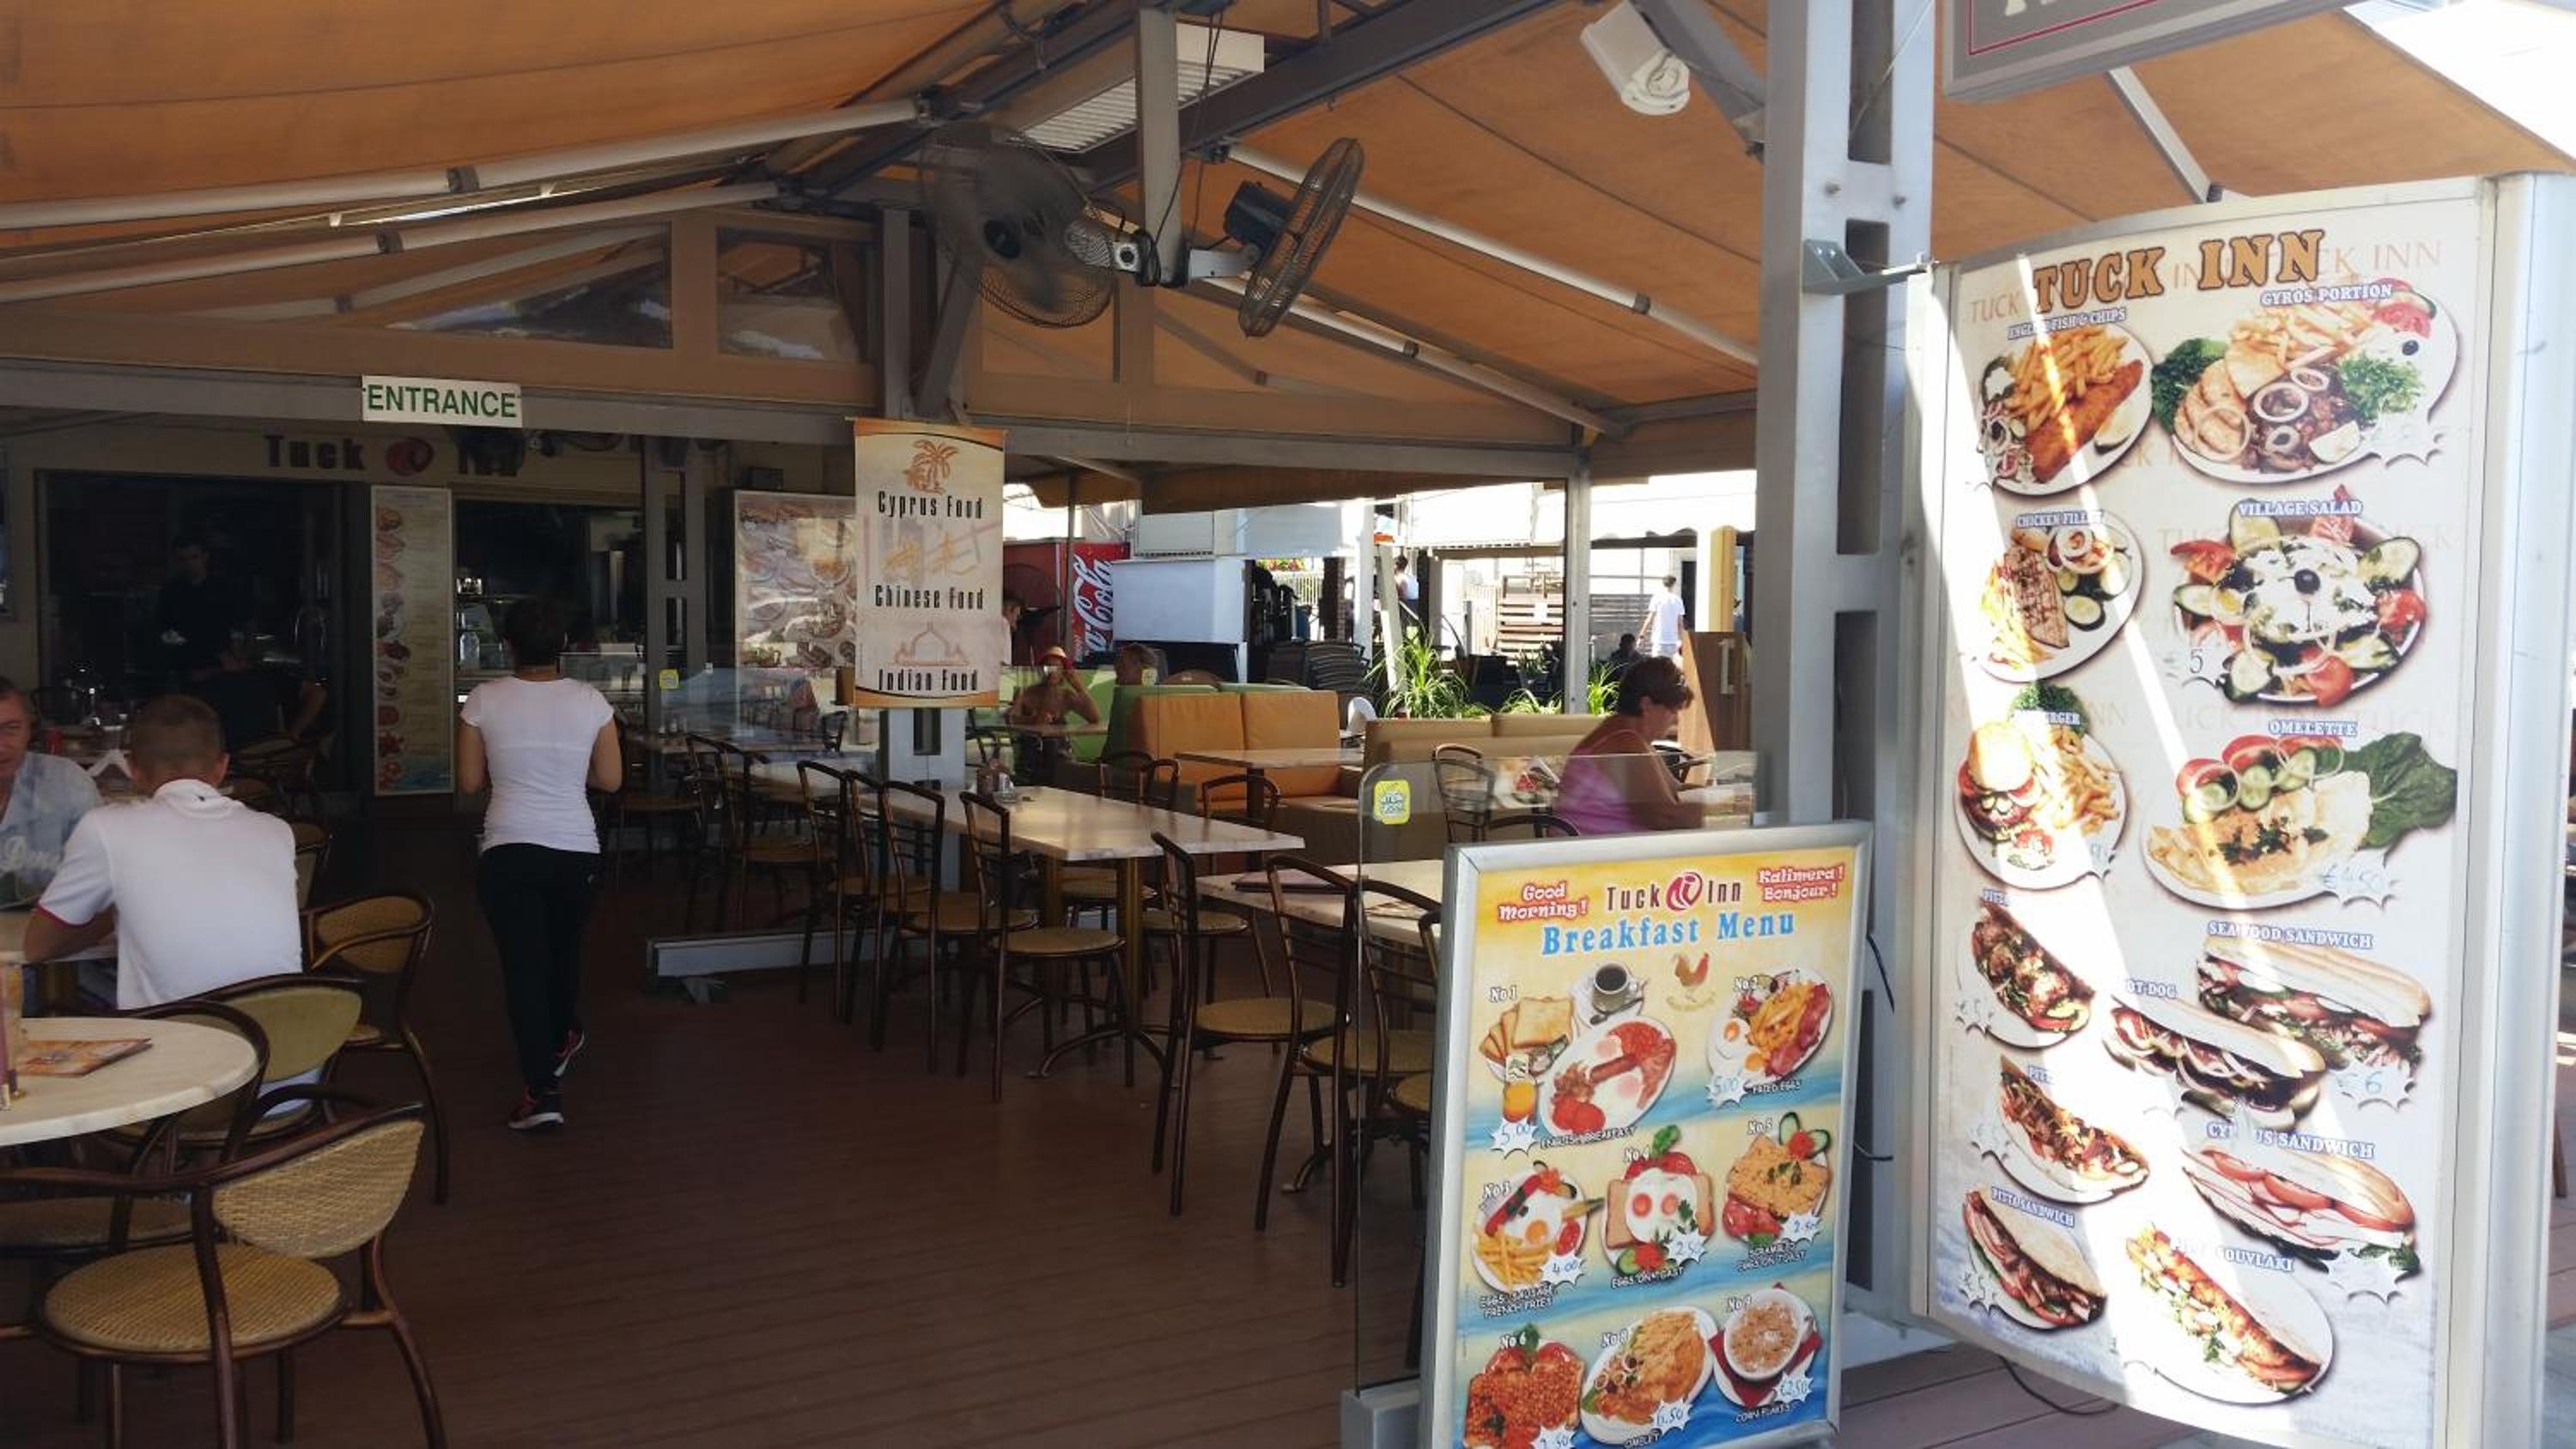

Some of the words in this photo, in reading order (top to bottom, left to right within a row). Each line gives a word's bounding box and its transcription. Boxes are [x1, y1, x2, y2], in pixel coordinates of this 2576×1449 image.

[2033, 247, 2165, 314] TUCK
[2198, 229, 2325, 290] INN
[2261, 288, 2313, 306] GYROS
[2318, 283, 2393, 304] PORTION
[367, 385, 517, 418] ENTRANCE
[264, 433, 367, 470] Tuck
[878, 491, 938, 517] Cyprus
[947, 495, 983, 519] Food
[2238, 501, 2306, 517] VILLAGE
[2309, 500, 2362, 516] SALAD
[875, 585, 941, 609] Chinese
[949, 587, 984, 611] Food
[878, 669, 933, 691] Indian
[941, 669, 979, 691] Food
[2269, 719, 2359, 737] OMELETTE
[1522, 882, 1567, 901] Good
[1607, 885, 1661, 912] Tuck
[1708, 880, 1741, 904] Inn
[1541, 915, 1700, 955] Breakfast
[1717, 912, 1795, 940] Menu
[2286, 929, 2373, 949] SANDWICH
[2278, 1132, 2375, 1158] SANDWICH
